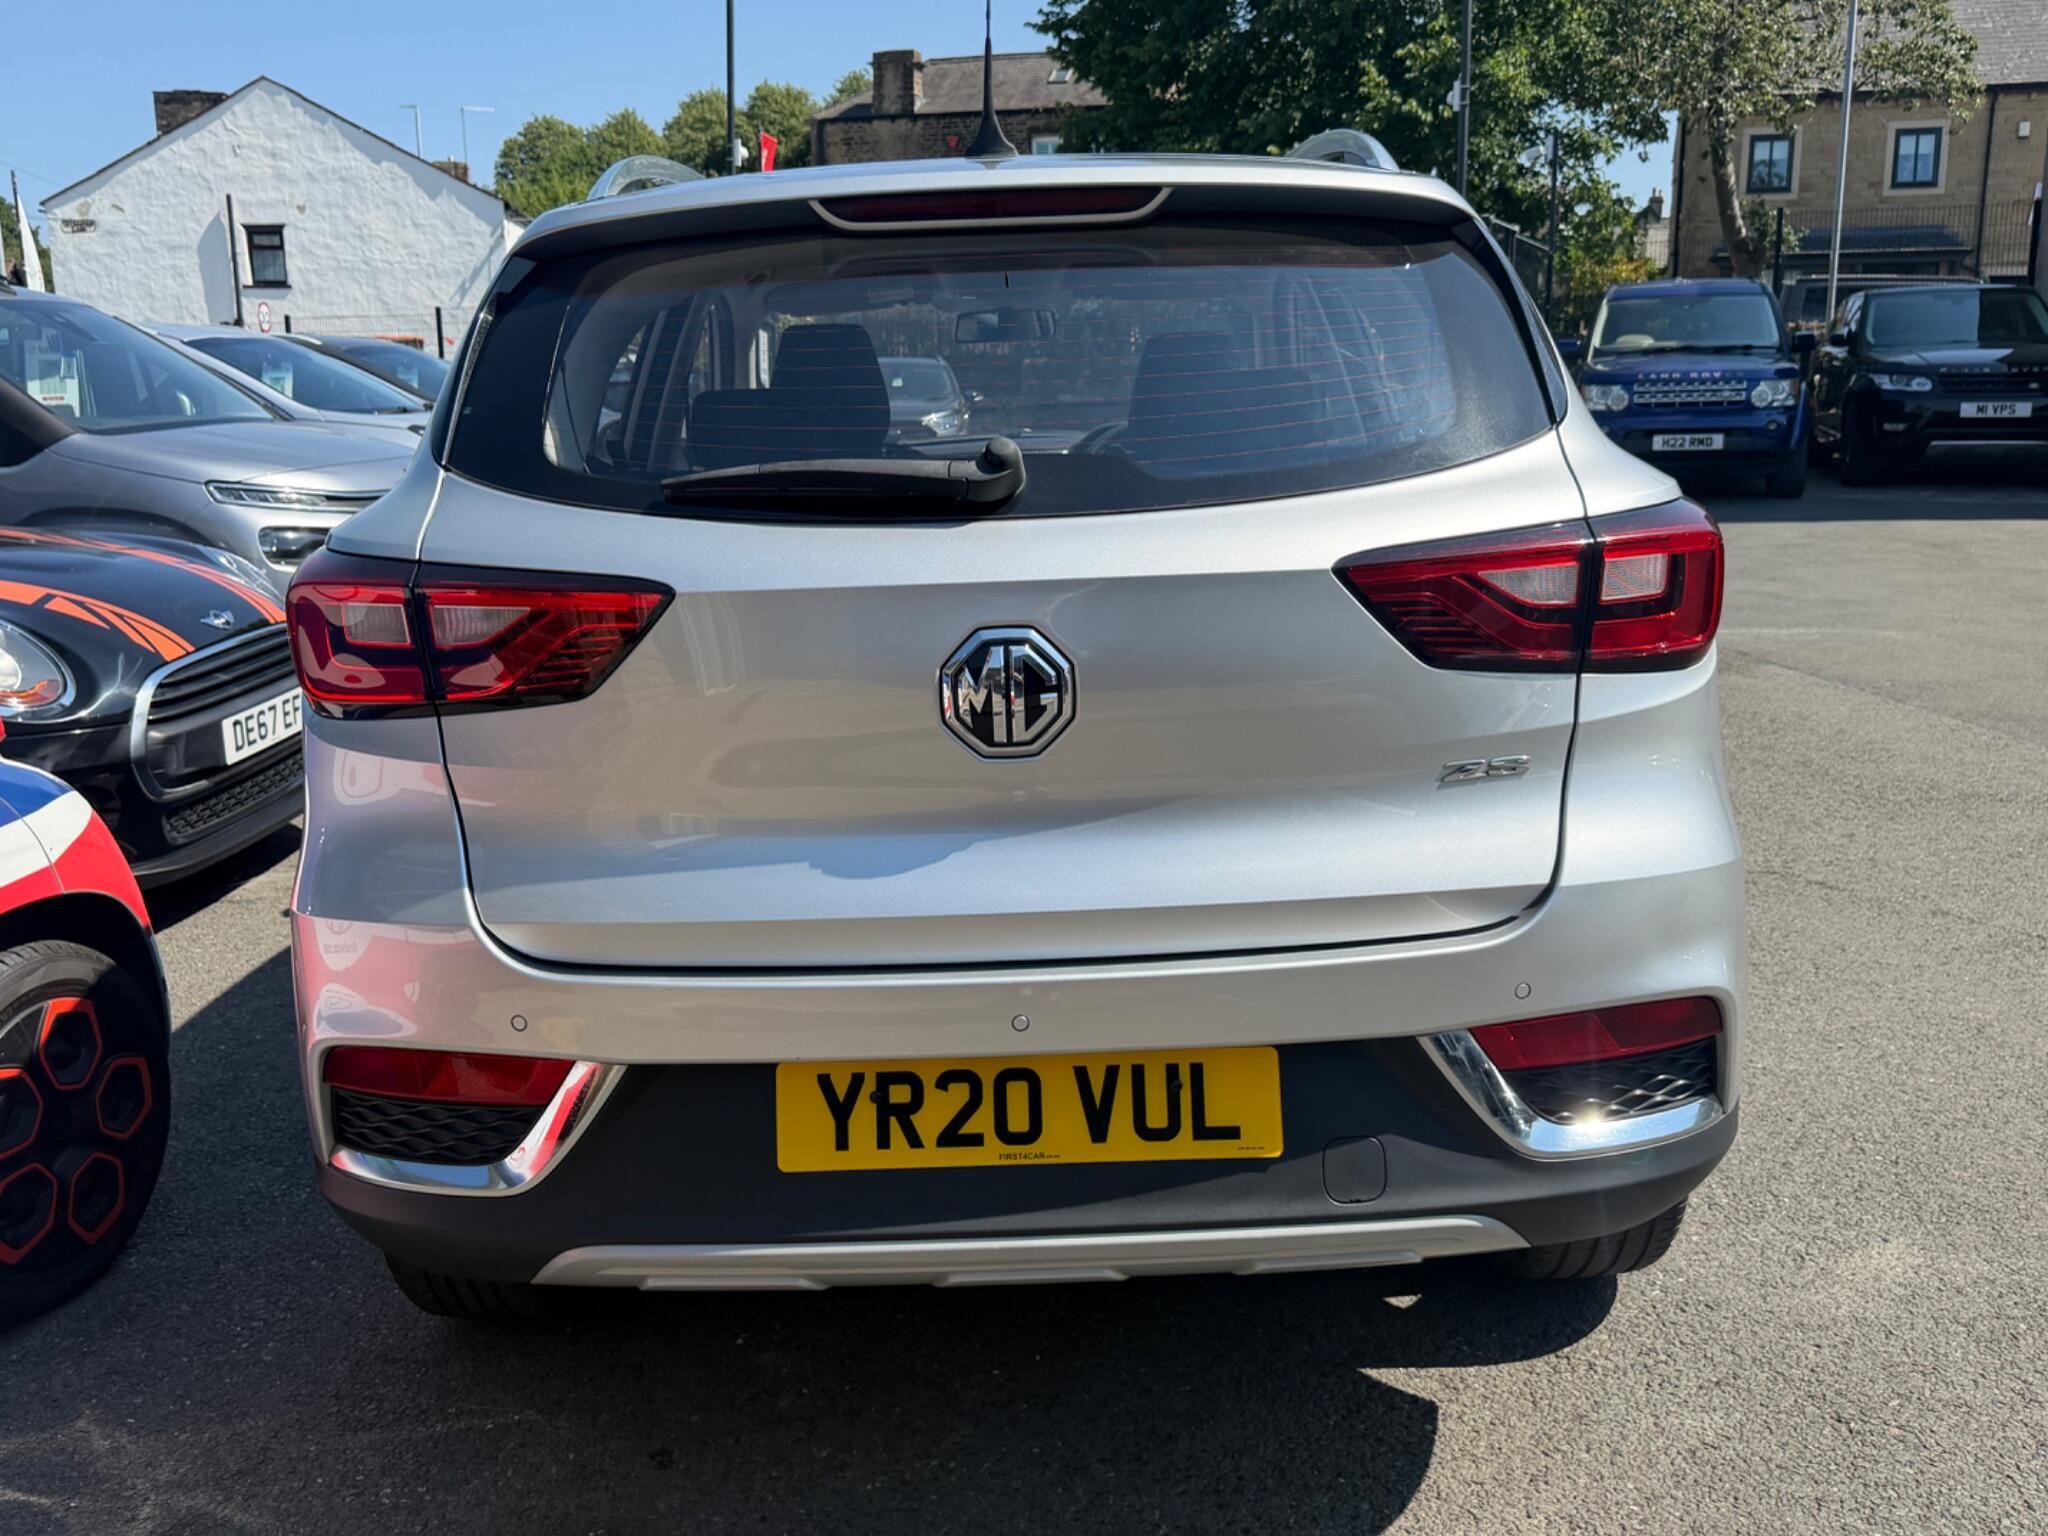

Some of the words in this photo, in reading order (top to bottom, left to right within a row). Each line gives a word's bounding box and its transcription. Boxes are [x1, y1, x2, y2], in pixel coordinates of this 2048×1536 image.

[1637, 372, 1681, 380] LAND
[1992, 403, 2016, 415] VPS
[1661, 437, 1687, 448] H22
[1688, 436, 1714, 448] RMD
[956, 642, 1060, 745] MG
[231, 703, 278, 752] DE67
[281, 693, 301, 730] EF
[816, 1066, 1043, 1152] YR20
[1072, 1061, 1242, 1145] VUL
